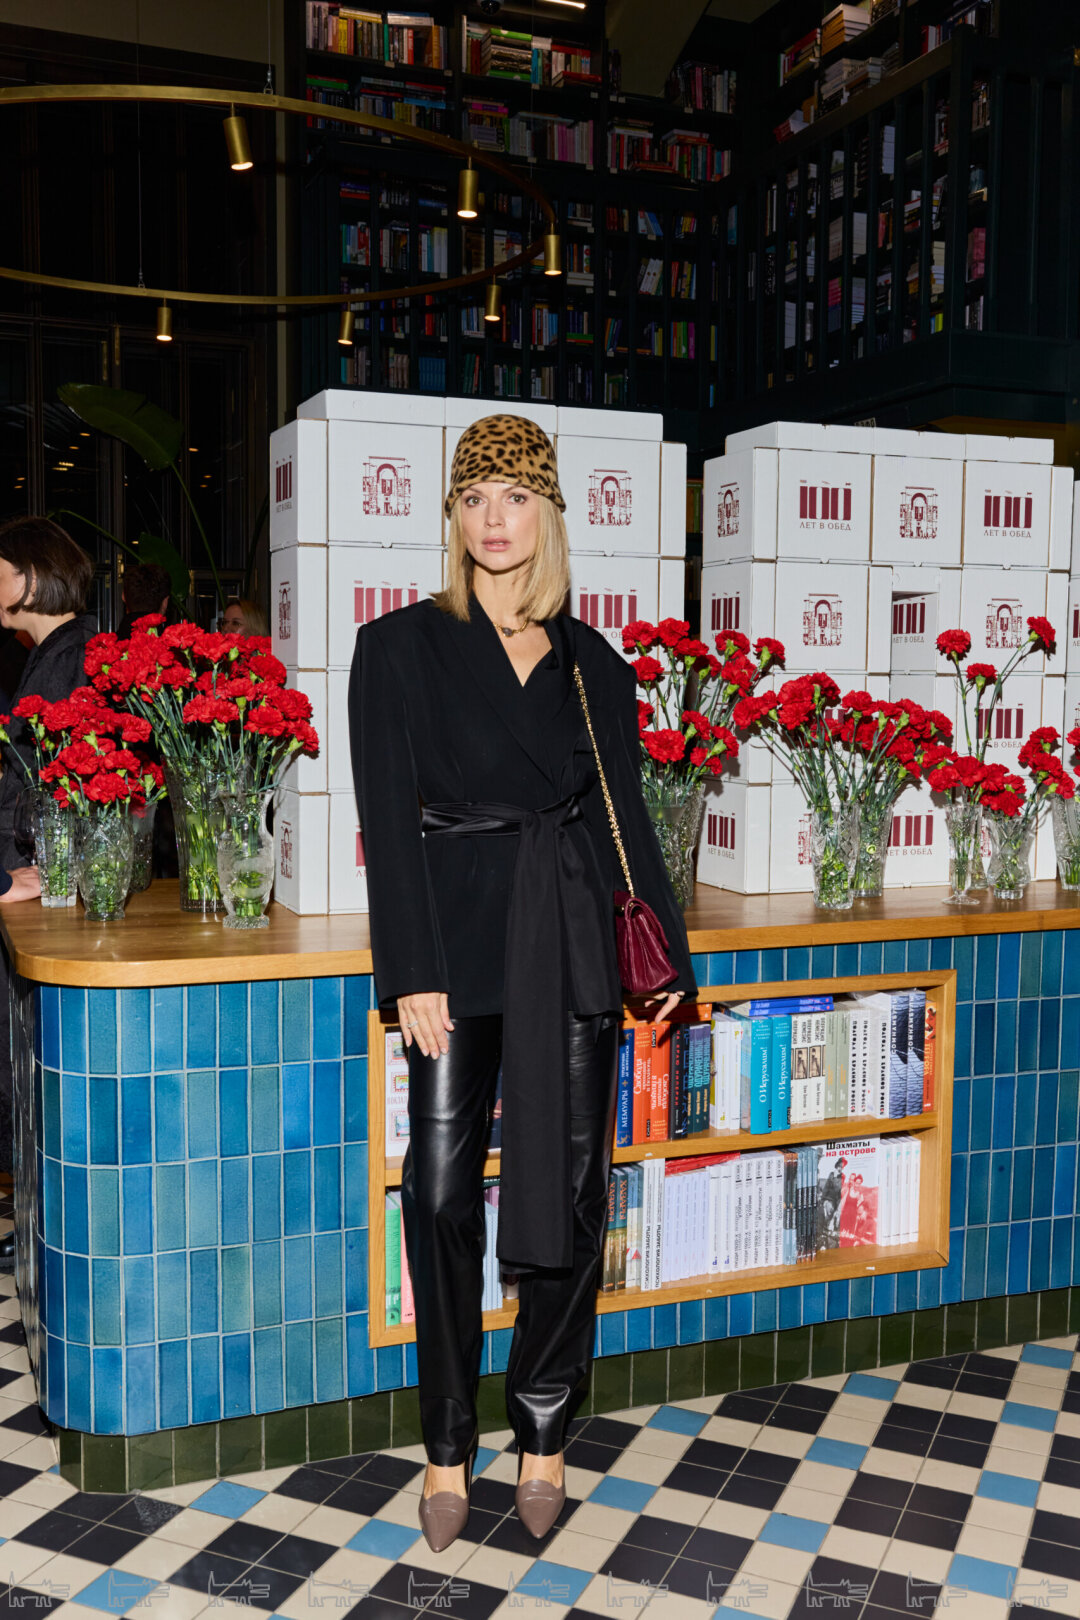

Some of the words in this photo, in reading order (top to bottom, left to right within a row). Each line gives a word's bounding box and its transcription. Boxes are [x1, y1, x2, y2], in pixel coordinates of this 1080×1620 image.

[760, 1046, 769, 1093] Иерусалим!
[779, 1044, 788, 1090] Иерусалим!
[621, 1090, 630, 1127] МЕМУАРЫ
[662, 1073, 670, 1109] Свобода
[759, 1095, 767, 1103] О
[778, 1092, 785, 1100] О
[827, 1141, 870, 1150] Шахматы
[839, 1147, 876, 1157] острове
[608, 1181, 616, 1222] ХАЗАРЫ
[619, 1179, 627, 1220] ХАЗАРЫ
